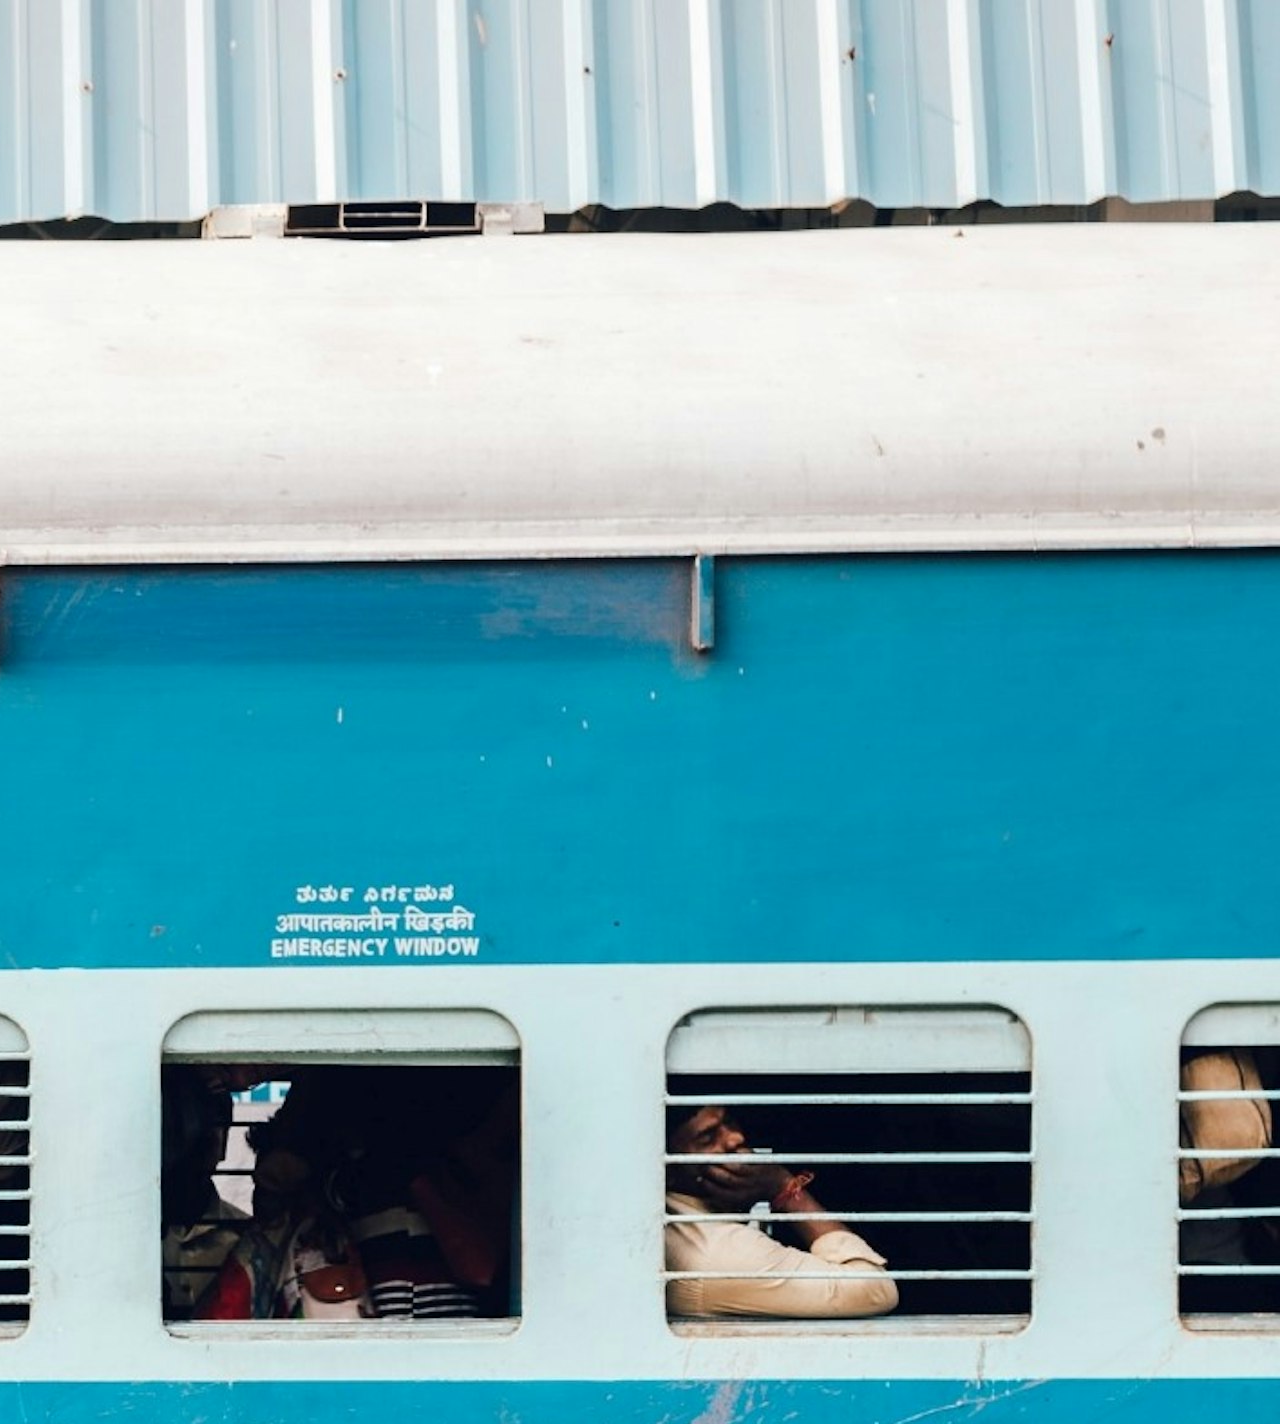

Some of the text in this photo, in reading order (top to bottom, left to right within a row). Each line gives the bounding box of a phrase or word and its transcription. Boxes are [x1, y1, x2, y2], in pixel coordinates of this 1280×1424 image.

[275, 905, 400, 933] आपातकालीन
[271, 937, 480, 958] EMERGENCY WINDOW
